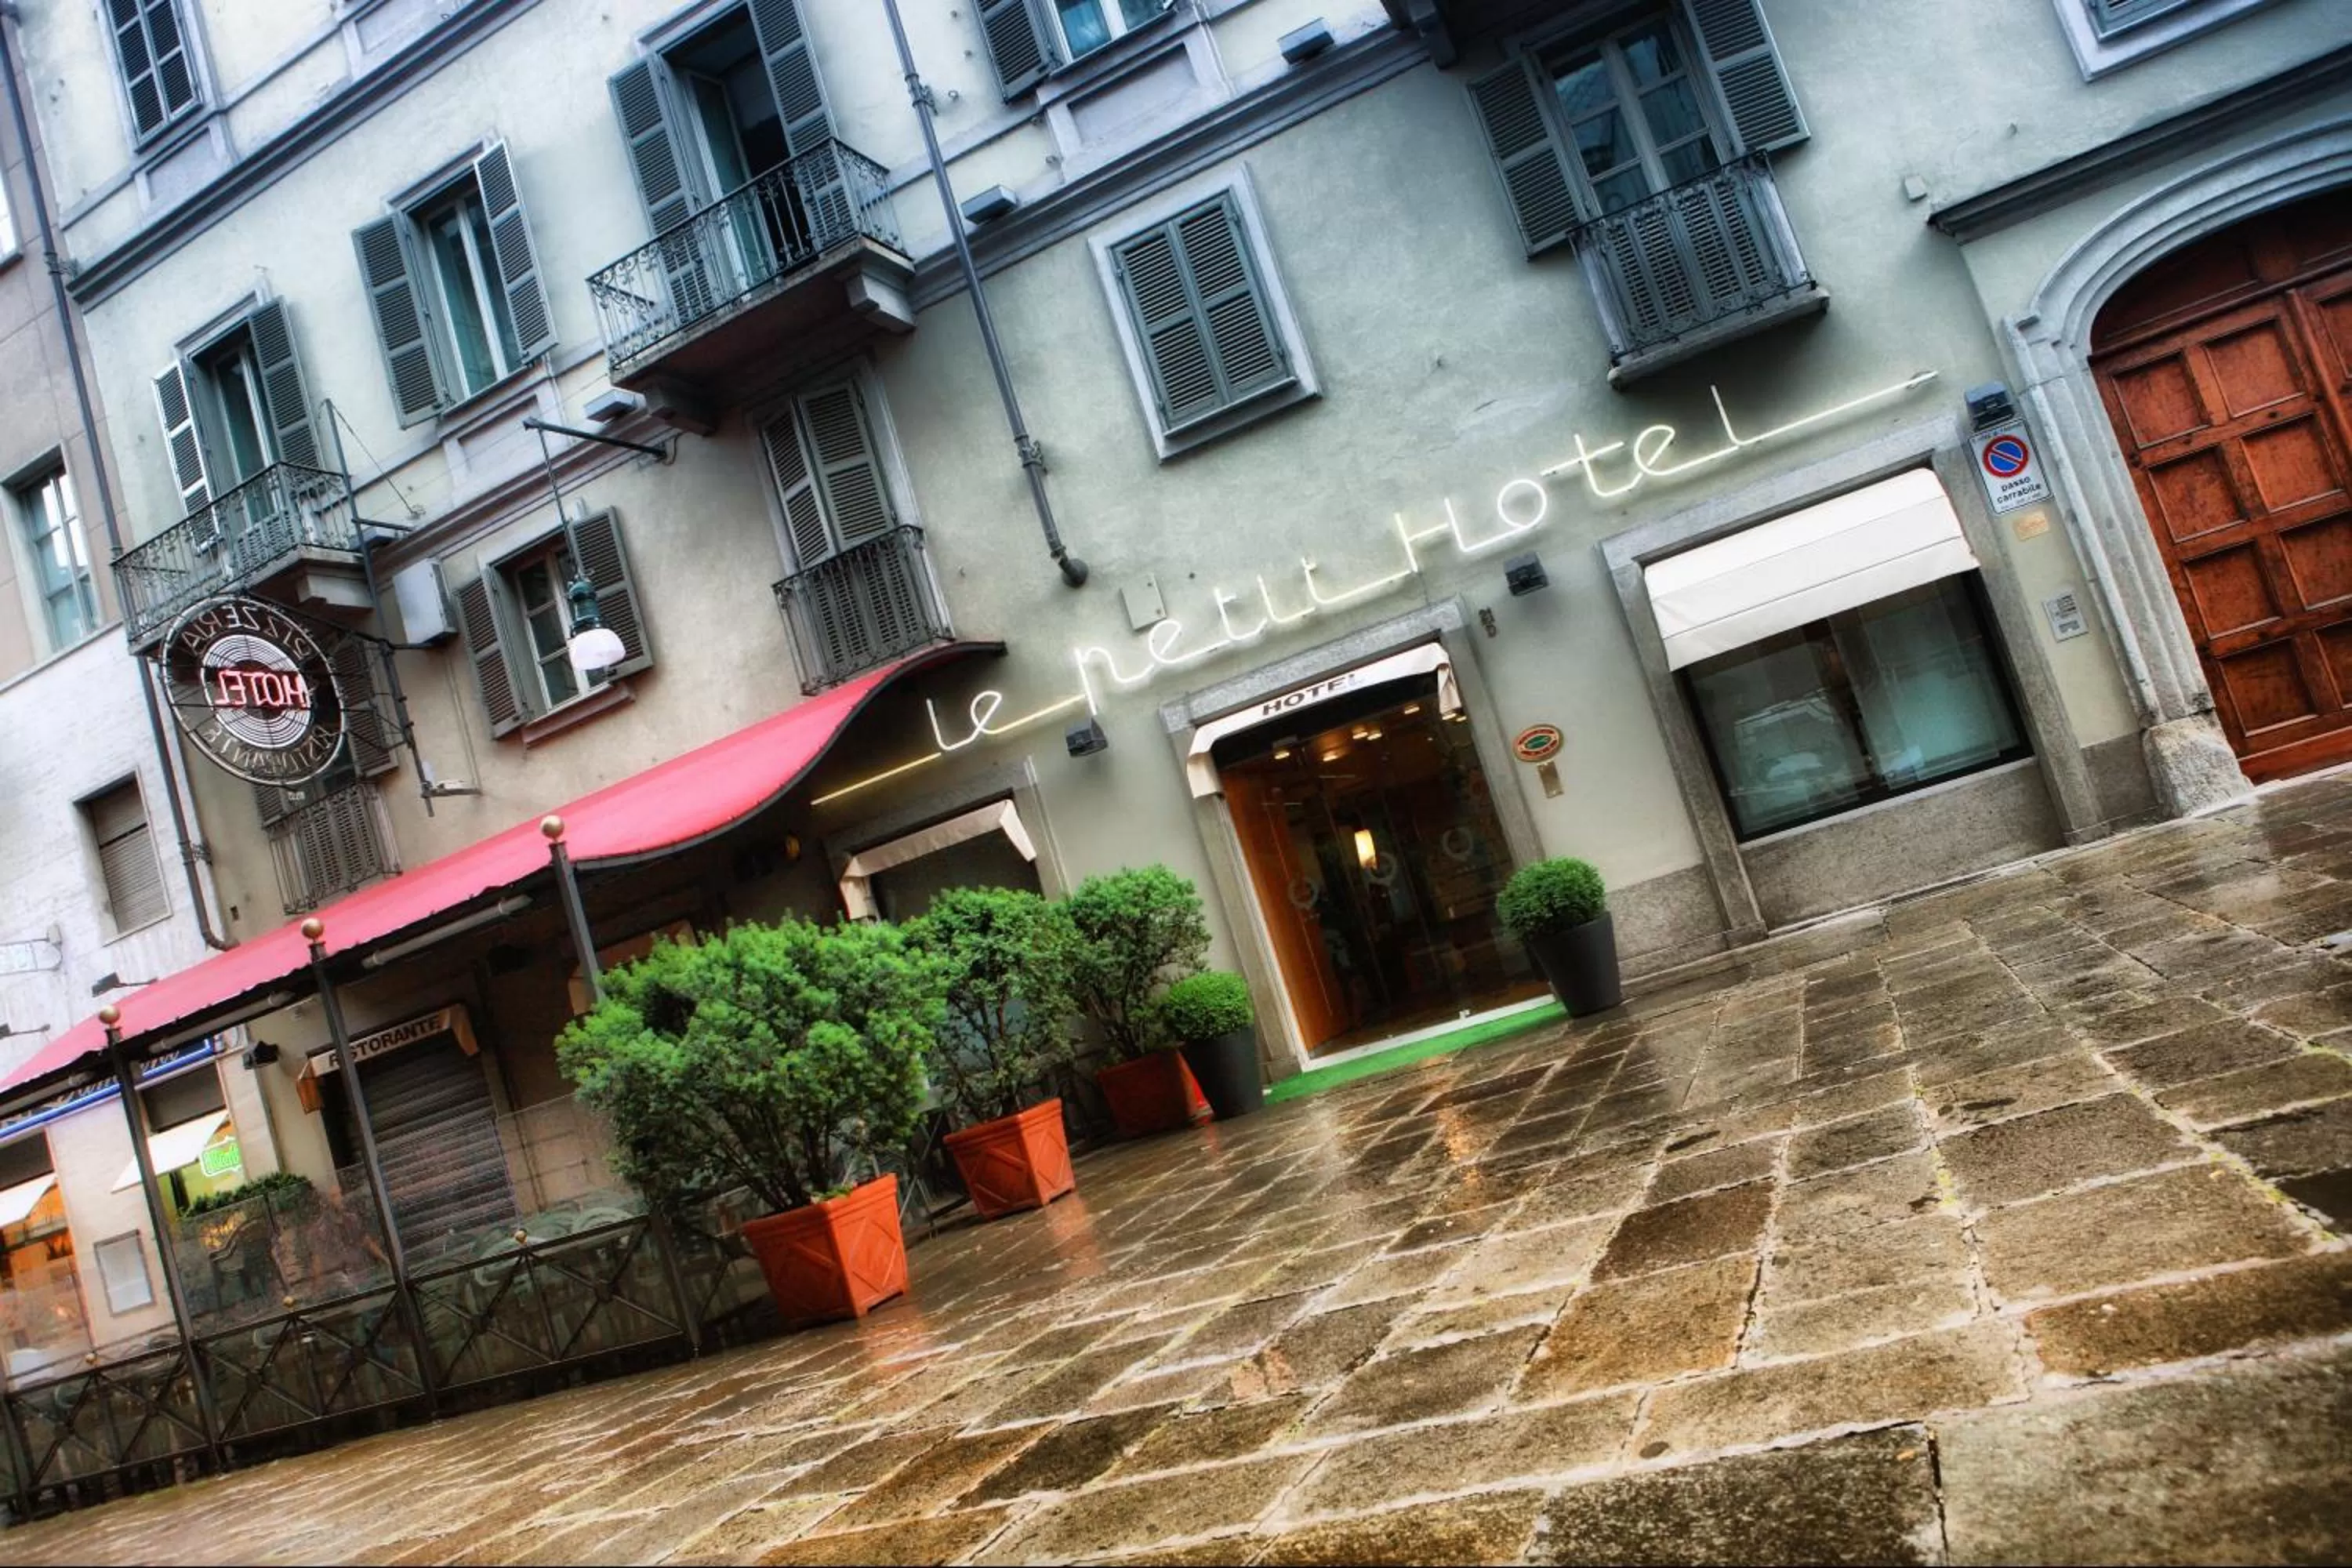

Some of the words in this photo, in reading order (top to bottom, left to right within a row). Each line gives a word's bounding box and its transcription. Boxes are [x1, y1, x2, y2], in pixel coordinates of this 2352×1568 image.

[1997, 484, 2042, 504] carrabile
[2001, 476, 2031, 492] passo
[328, 1015, 441, 1069] RSTORANTE
